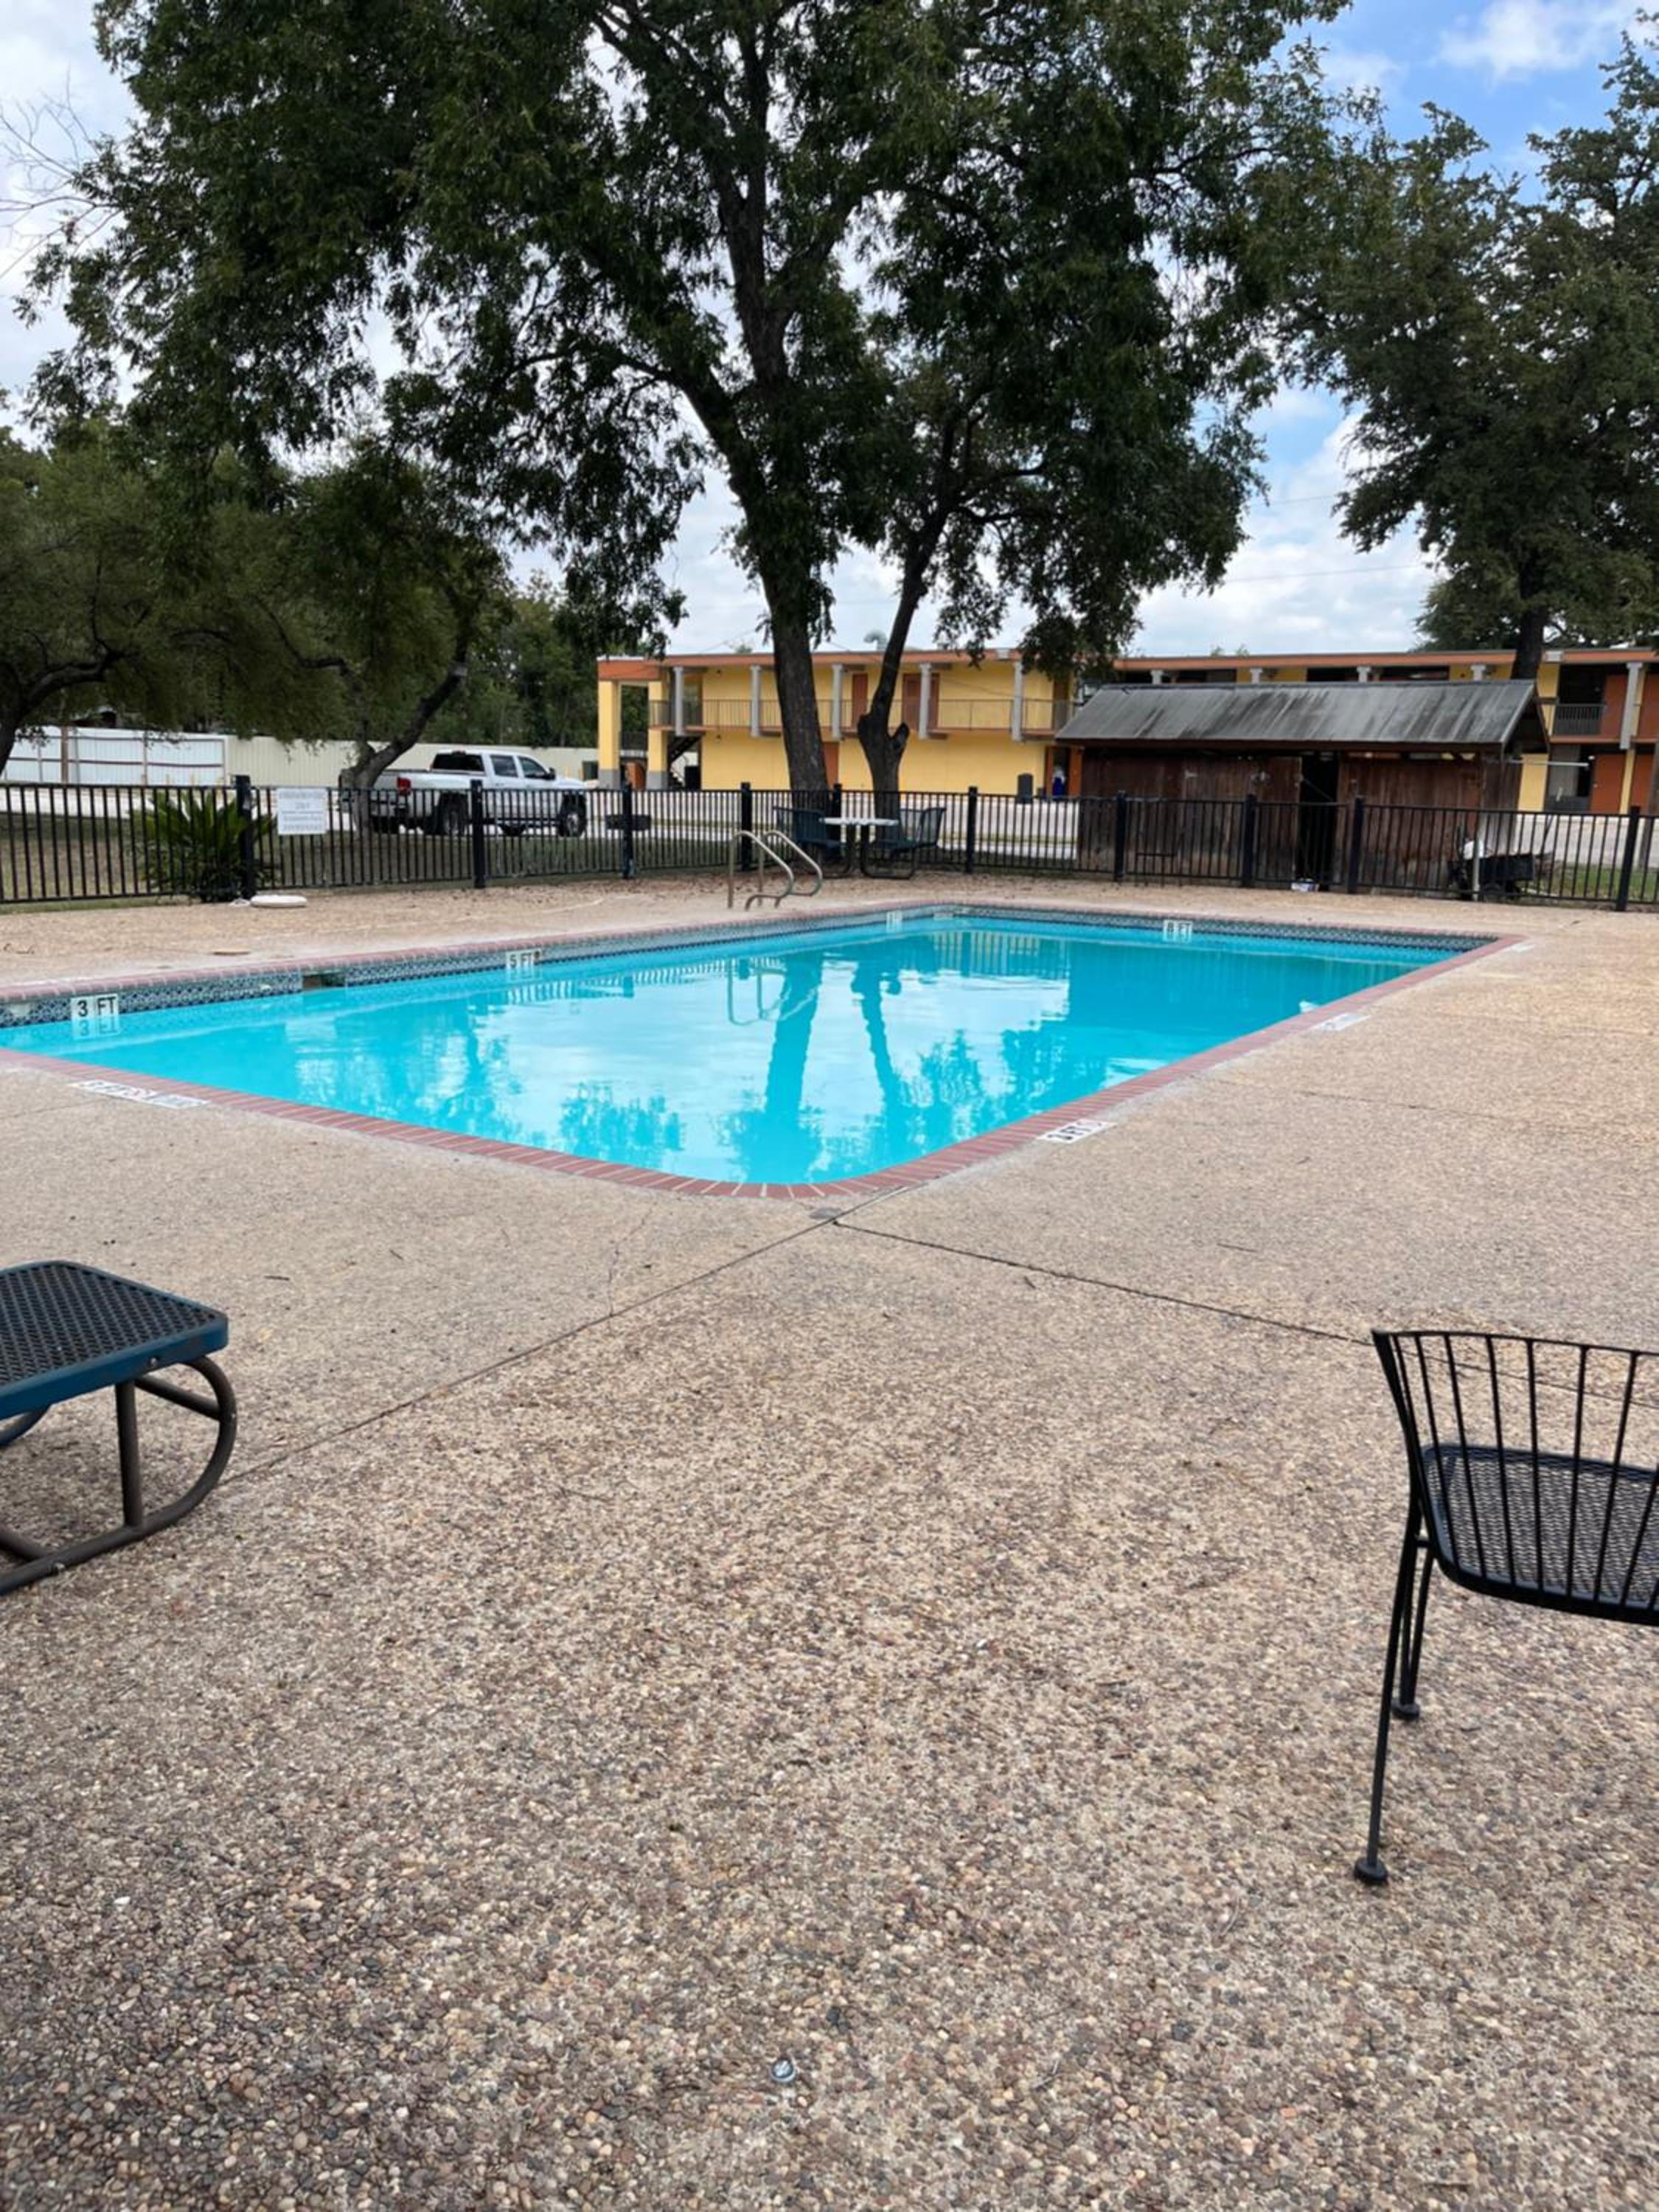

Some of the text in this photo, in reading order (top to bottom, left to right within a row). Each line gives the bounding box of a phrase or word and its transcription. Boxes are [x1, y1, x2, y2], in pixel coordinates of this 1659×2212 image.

[509, 953, 532, 968] 5 FT
[77, 996, 116, 1017] 3 FT
